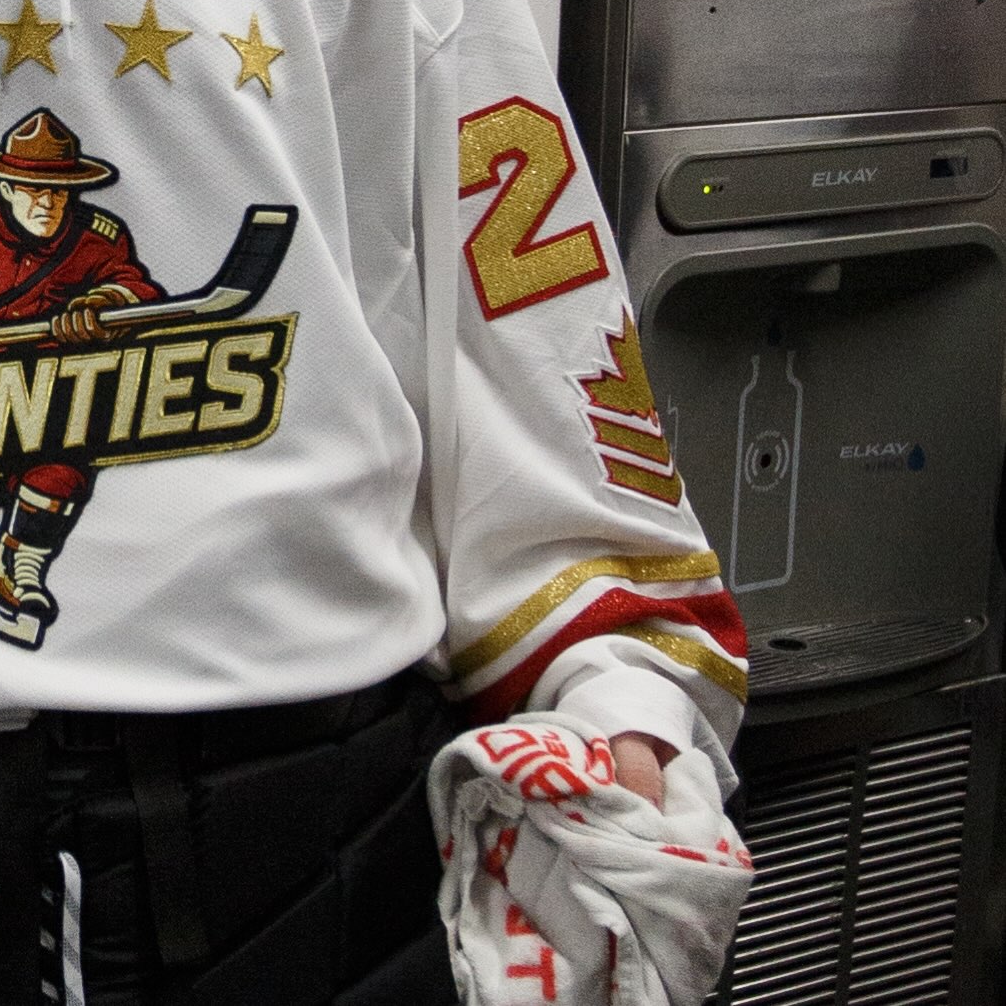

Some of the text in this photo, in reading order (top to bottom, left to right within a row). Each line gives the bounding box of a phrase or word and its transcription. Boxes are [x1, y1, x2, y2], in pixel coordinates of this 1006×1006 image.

[811, 167, 878, 188] ELKAY
[458, 96, 610, 321] 2
[839, 441, 909, 459] ELKAY
